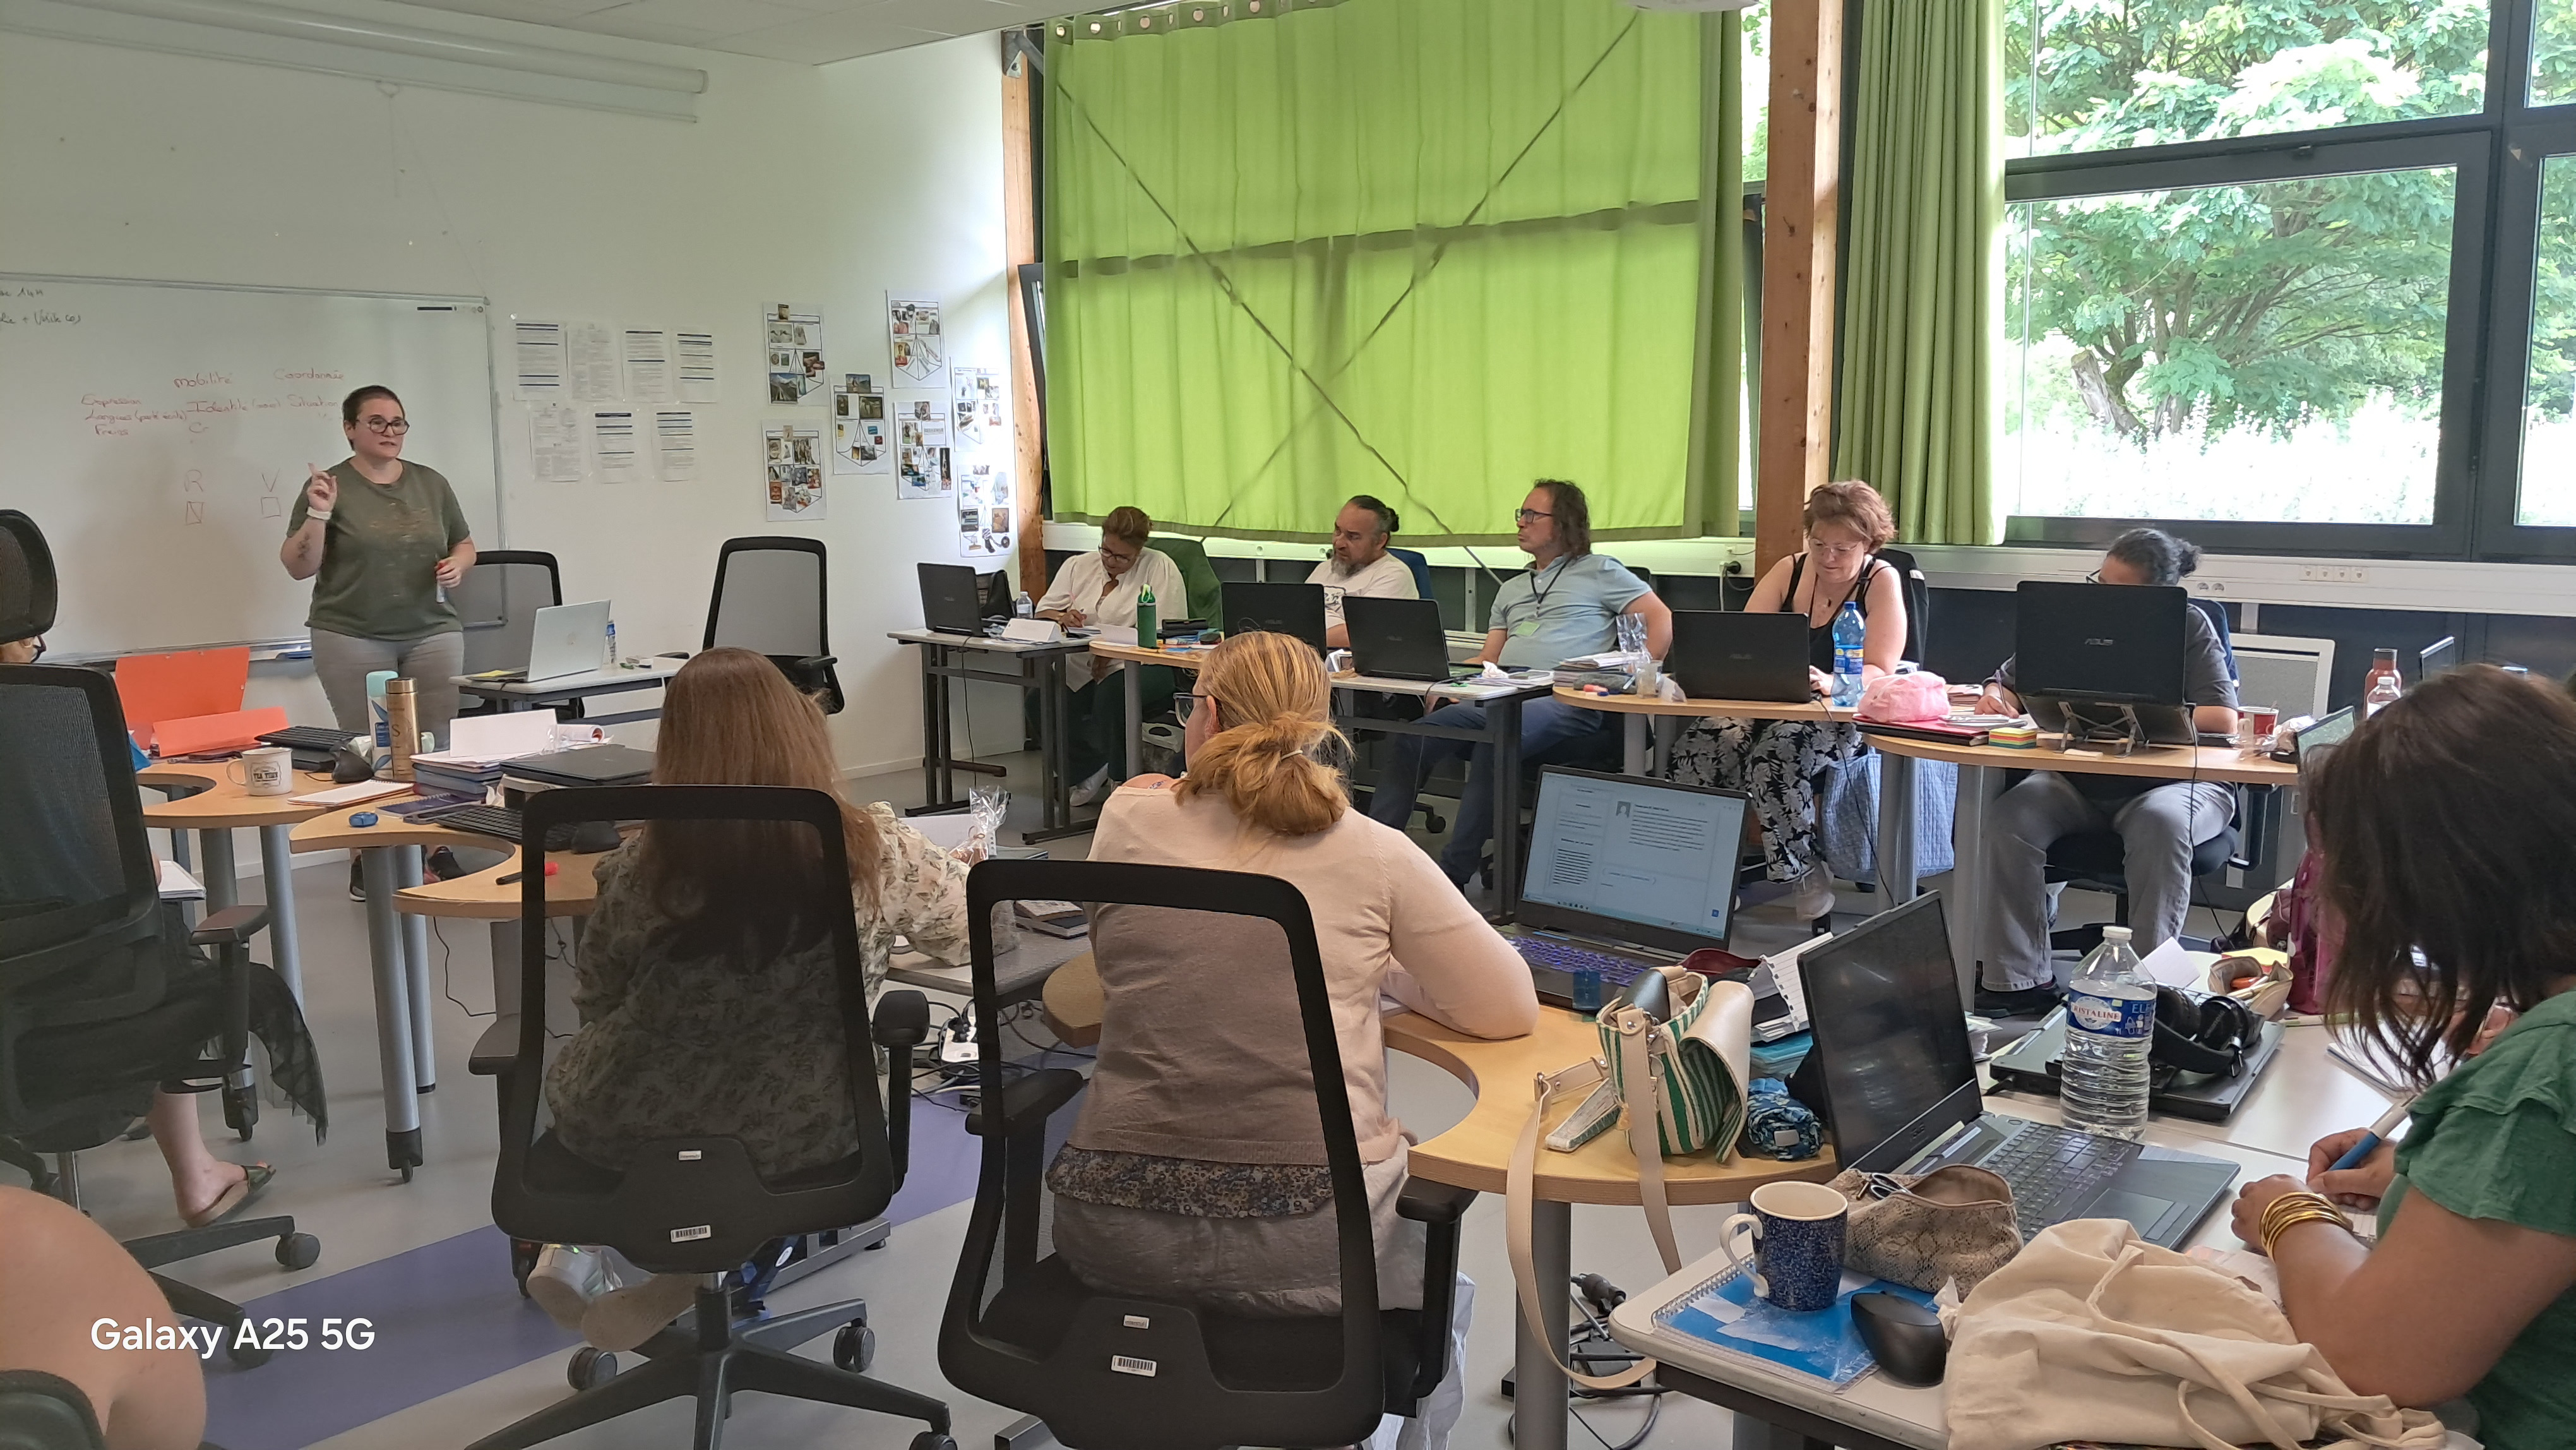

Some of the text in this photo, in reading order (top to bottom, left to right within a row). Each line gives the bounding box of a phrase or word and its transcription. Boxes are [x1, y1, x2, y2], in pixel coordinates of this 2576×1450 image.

[184, 468, 281, 493] R V
[2071, 1005, 2120, 1020] RISTALINE
